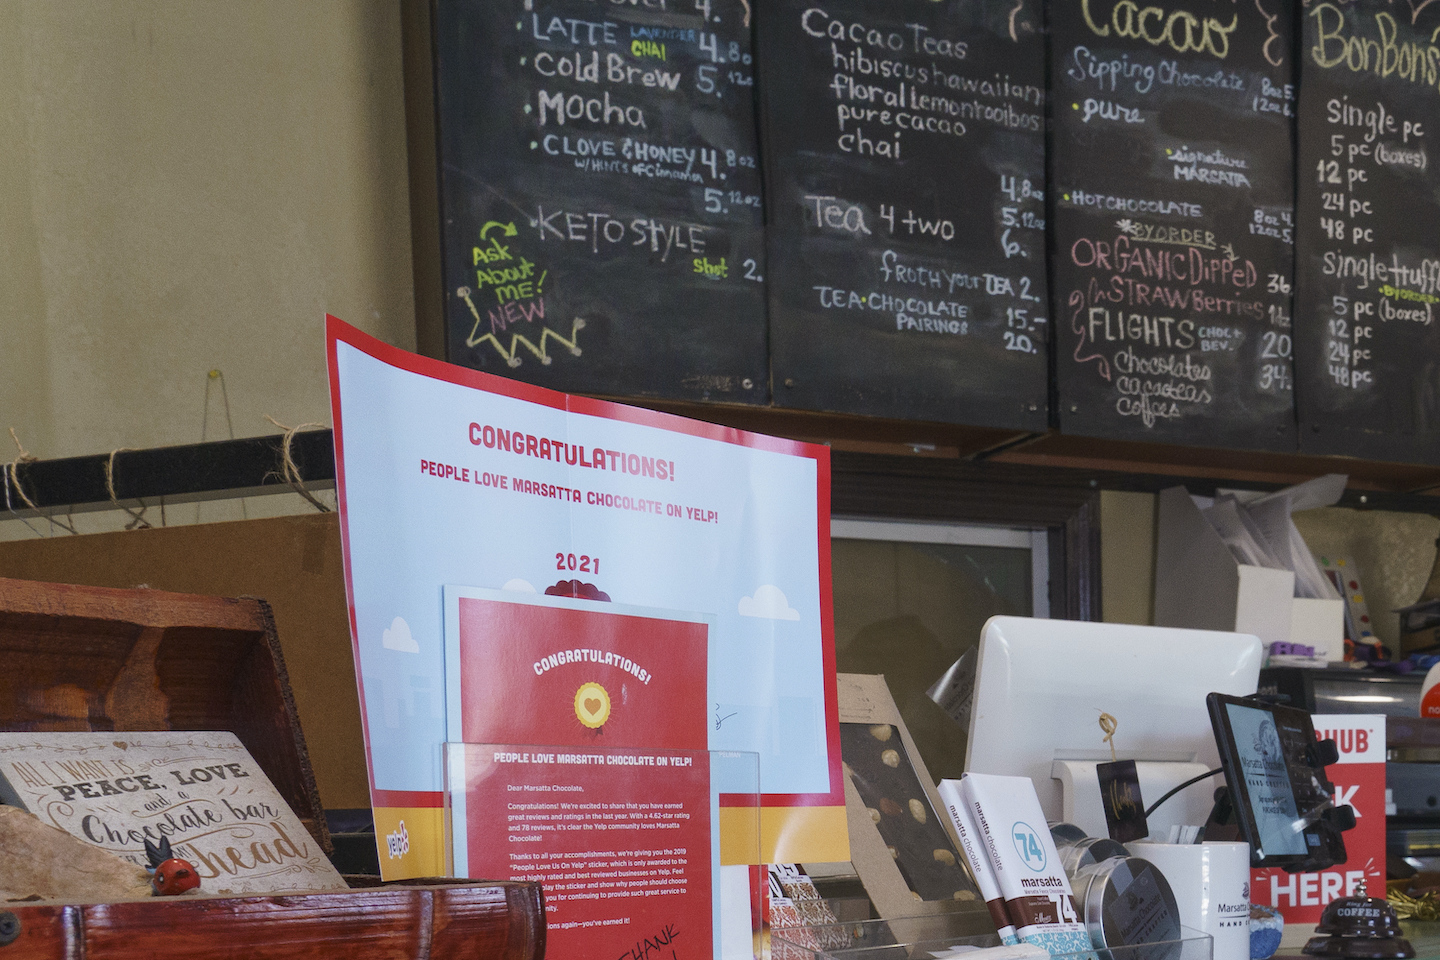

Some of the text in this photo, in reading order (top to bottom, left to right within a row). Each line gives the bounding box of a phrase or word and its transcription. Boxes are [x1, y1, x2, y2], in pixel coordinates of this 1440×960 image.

[532, 13, 619, 44] LATTE
[801, 8, 968, 59] Cacao Teas
[631, 40, 667, 61] CHAI
[831, 41, 928, 83] hibiscus
[1068, 46, 1245, 93] Sipping Chocolate
[829, 73, 905, 107] floral
[538, 89, 646, 129] Mocha
[838, 104, 966, 136] pure cacao
[1327, 95, 1398, 142] Single
[543, 134, 616, 156] CLOVE
[838, 127, 901, 159] chai
[1317, 160, 1342, 184] 12
[804, 195, 871, 235] Tea
[902, 210, 955, 240] two
[1107, 196, 1203, 217] CHOCOLATE
[1320, 217, 1344, 240] 48
[472, 238, 514, 266] Ask
[1071, 235, 1185, 281] ORGANIC
[1323, 249, 1389, 289] Single
[488, 298, 545, 334] NEW
[896, 313, 968, 334] PAIRINGS
[1089, 307, 1195, 348] FLIGHTS
[468, 422, 675, 482] CONGRATULATIONS!
[421, 459, 718, 524] PEOPLE LOVE MARSATTA CHOCOLATE ON YELP!
[555, 552, 600, 574] 2021
[533, 649, 652, 685] CONGRATULATIONS!
[11, 758, 134, 787] ALL WANT IS
[494, 752, 692, 767] PEOPLE LOVE MARSATTA CHOCOLATE ON YELP!
[53, 763, 250, 801] PEACE, LOVE
[552, 784, 584, 792] Chocolate,
[144, 789, 190, 812] and a
[82, 798, 279, 846] Chocolate bar
[950, 804, 982, 873] marsatta chocolate
[975, 801, 1003, 871] marsatta chocolate
[186, 821, 308, 878] head
[1015, 833, 1042, 862] 74
[1021, 876, 1063, 888] marsatta
[1218, 903, 1246, 913] Marsatta
[1337, 907, 1380, 917] COFFEE
